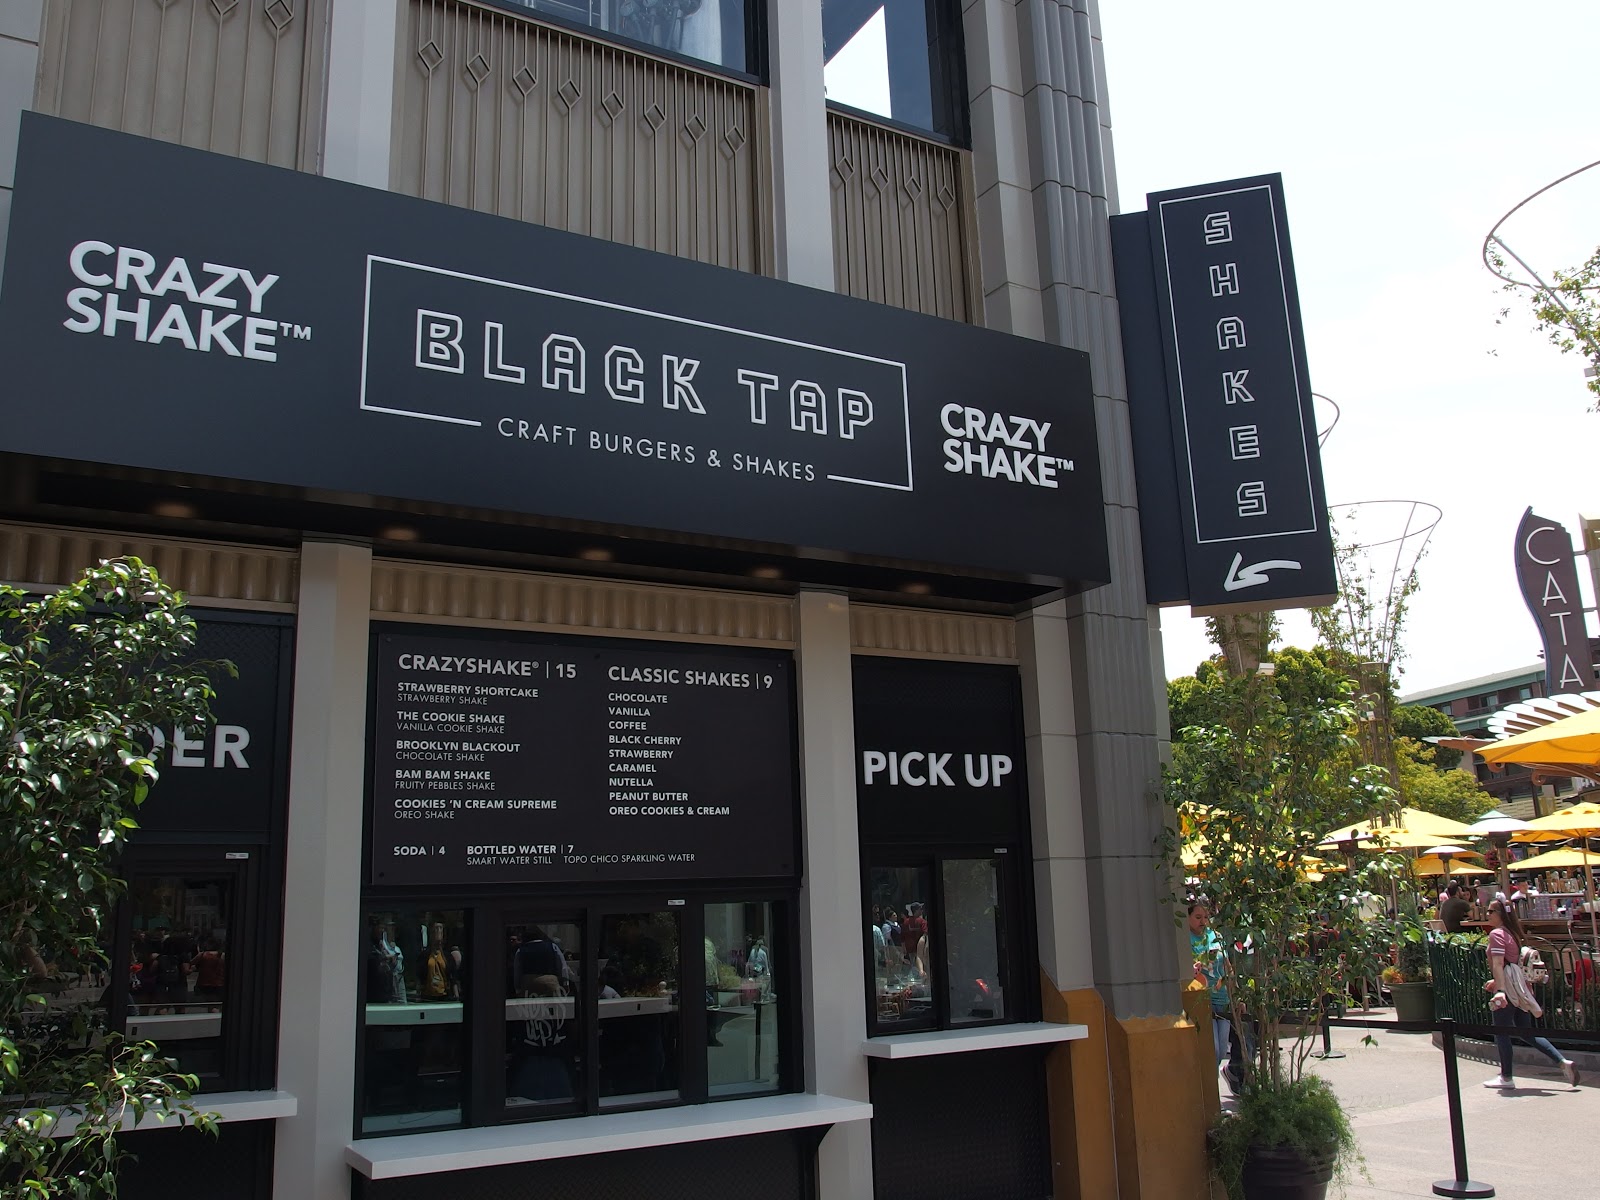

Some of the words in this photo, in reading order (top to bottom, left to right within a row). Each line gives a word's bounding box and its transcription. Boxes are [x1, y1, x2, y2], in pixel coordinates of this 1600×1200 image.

[69, 240, 280, 314] CRAZY
[1204, 211, 1268, 517] SHAKES
[415, 308, 707, 415] BLACK
[737, 368, 874, 440] TAP
[940, 403, 1052, 452] CRAZY
[497, 417, 577, 446] CRAFT
[589, 431, 697, 464] BURGERS
[707, 449, 722, 468] &
[732, 453, 816, 482] SHAKES
[556, 664, 576, 678] 15
[608, 666, 679, 684] CLASSIC
[685, 671, 750, 688] SHAKES
[764, 675, 772, 688] 9
[398, 683, 471, 694] STRAWBERRY
[475, 686, 538, 697] SHORTCAKE
[398, 694, 456, 704] STRAWBERRY
[459, 696, 487, 705] SHAKE
[608, 693, 667, 703] CHOCOLATE
[608, 707, 650, 716] VANILLA
[397, 711, 419, 720] THE
[422, 712, 465, 722] COOKIE
[469, 714, 505, 724] SHAKE
[397, 723, 434, 731] VANILLA
[437, 724, 473, 733] COOKIE
[476, 725, 504, 734] SHAKE
[608, 721, 647, 730] COFFEE
[608, 735, 640, 744] BLACK
[644, 736, 681, 745] CHERRY
[396, 741, 459, 750] BROOKLYN
[463, 743, 520, 752] BLACKOUT
[396, 752, 452, 761] CHOCOLATE
[456, 753, 485, 761] SHAKE
[608, 749, 673, 758] STRAWBERRY
[609, 764, 656, 772] CARAMEL
[863, 750, 956, 787] PICK
[964, 753, 1013, 788] UP
[396, 770, 421, 778] BAM
[425, 771, 450, 779] BAM
[454, 771, 490, 780] SHAKE
[395, 781, 425, 789] FRUITY
[428, 782, 463, 790] PEBBLES
[467, 782, 495, 790] SHAKE
[609, 778, 653, 787] NUTELLA
[609, 793, 649, 801] PEANUT
[652, 793, 688, 801] BUTTER
[395, 799, 446, 808] COOKIES
[465, 800, 503, 808] CREAM
[507, 800, 557, 809] SUPREME
[394, 811, 421, 819] OREO
[425, 811, 454, 819] SHAKE
[609, 807, 638, 815] OREO
[641, 807, 684, 815] COOKIES
[688, 807, 694, 815] &
[697, 807, 730, 815] CREAM
[394, 846, 426, 856] SODA
[439, 846, 445, 855] 4
[467, 846, 515, 854] BOTTLED
[519, 845, 556, 854] WATER
[568, 845, 574, 853] 7
[467, 857, 496, 865] SMART
[500, 856, 530, 864] WATER
[533, 856, 552, 864] STILL
[564, 855, 587, 864] TOPO
[590, 855, 618, 863] CHICO
[621, 854, 665, 863] SPARKLING
[668, 854, 695, 862] WATER
